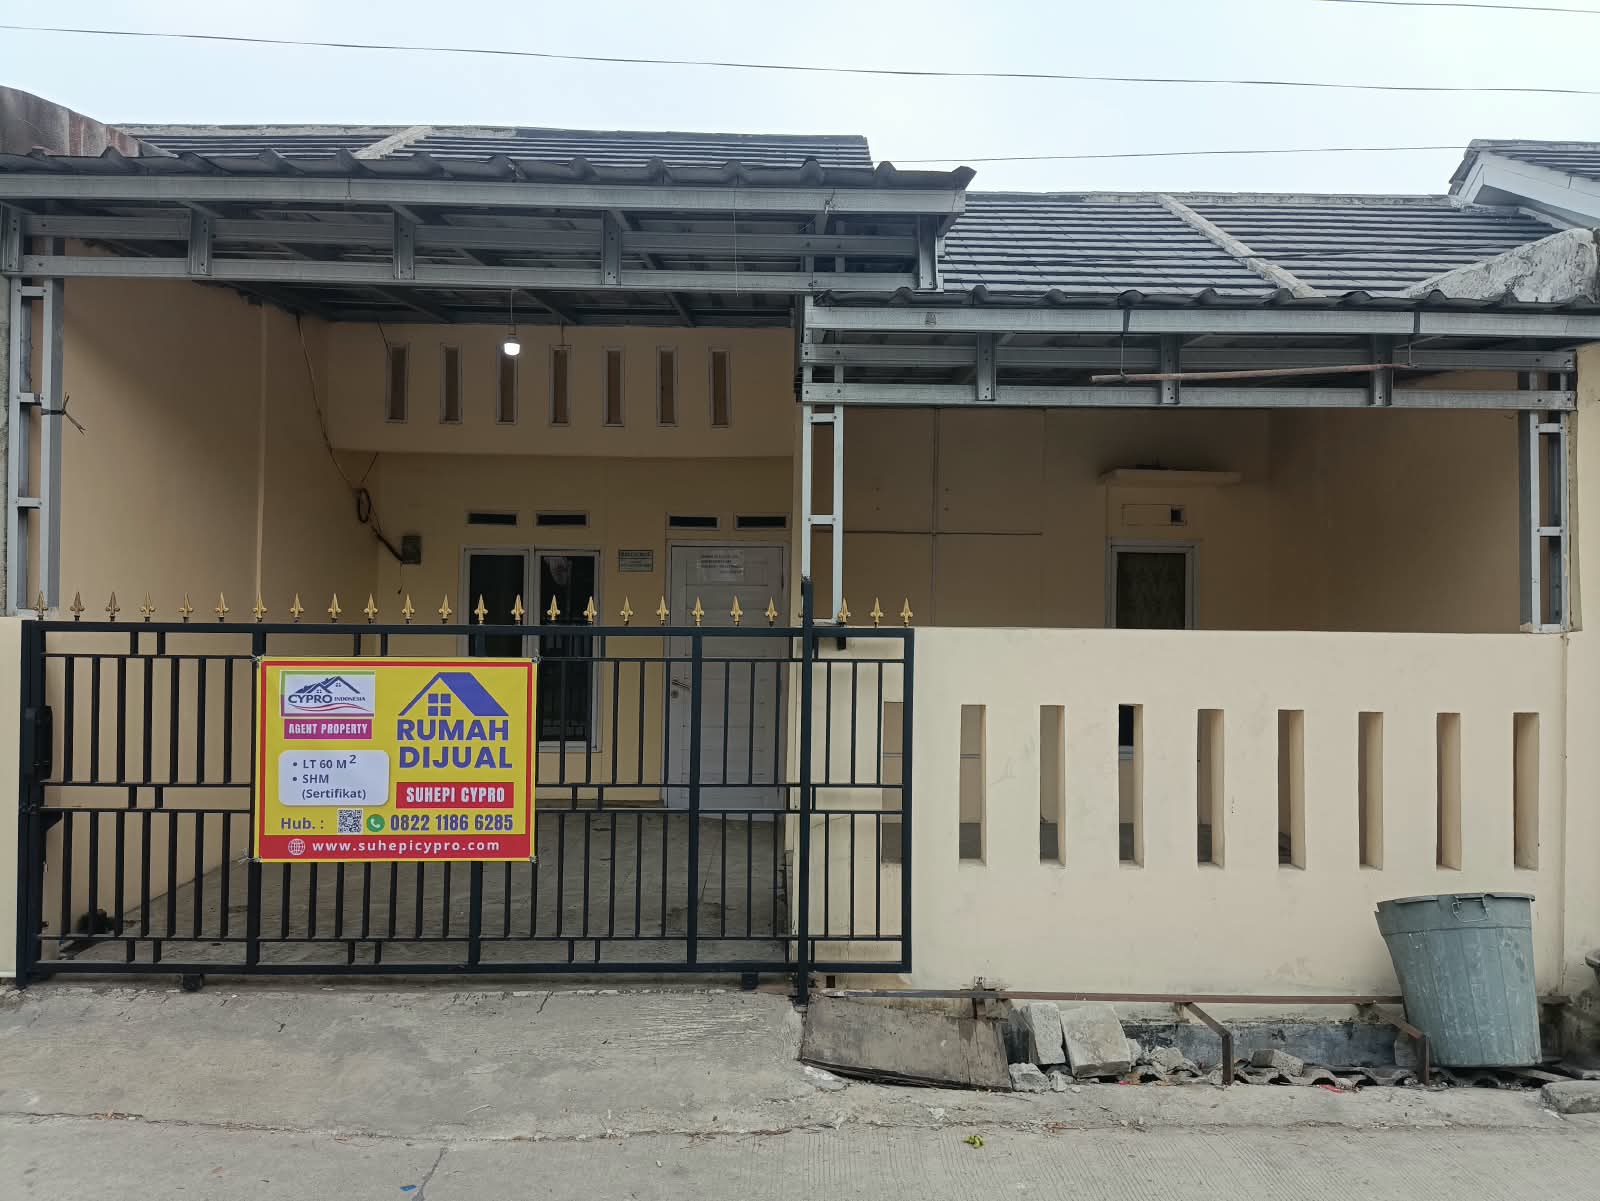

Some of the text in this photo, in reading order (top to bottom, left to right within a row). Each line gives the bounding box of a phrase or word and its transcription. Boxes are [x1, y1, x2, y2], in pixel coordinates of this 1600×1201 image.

[288, 694, 333, 704] CYPRO
[288, 723, 368, 735] AGENT PROPERTY
[397, 719, 508, 741] RUMAH
[302, 759, 316, 769] LT
[319, 759, 333, 769] 60
[399, 746, 513, 769] DIJUAL
[302, 774, 329, 784] SHM
[302, 788, 366, 800] (Sertifikat)
[406, 787, 505, 803] SUHEPI CYPRO
[280, 817, 316, 831] Hub.
[390, 814, 513, 831] 0822 1186 6285
[312, 839, 500, 854] www.suhepicypro.com
